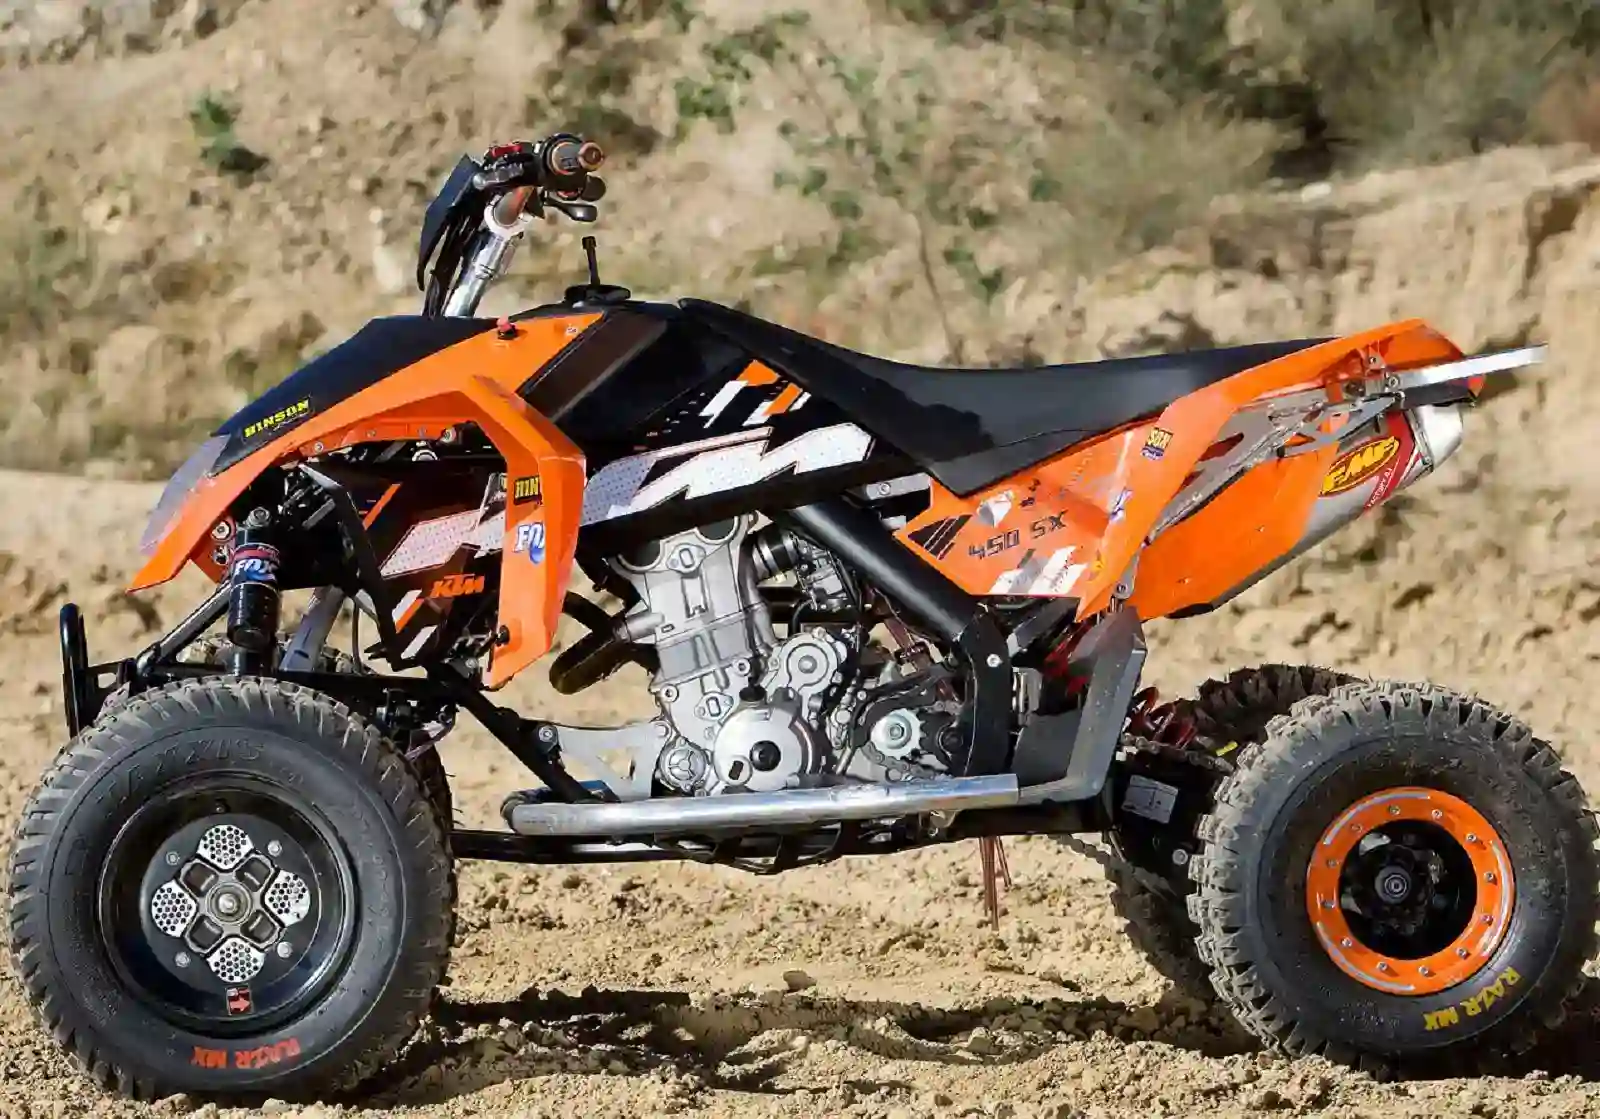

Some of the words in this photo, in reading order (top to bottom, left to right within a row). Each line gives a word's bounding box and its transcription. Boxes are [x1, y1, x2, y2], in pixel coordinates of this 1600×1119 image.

[1321, 436, 1396, 494] FMF
[968, 529, 1020, 560] 450
[1031, 509, 1069, 540] SX
[429, 573, 485, 599] KTM
[1460, 966, 1521, 1017] RAZR
[1423, 1006, 1459, 1031] MX
[189, 1045, 228, 1069] MX
